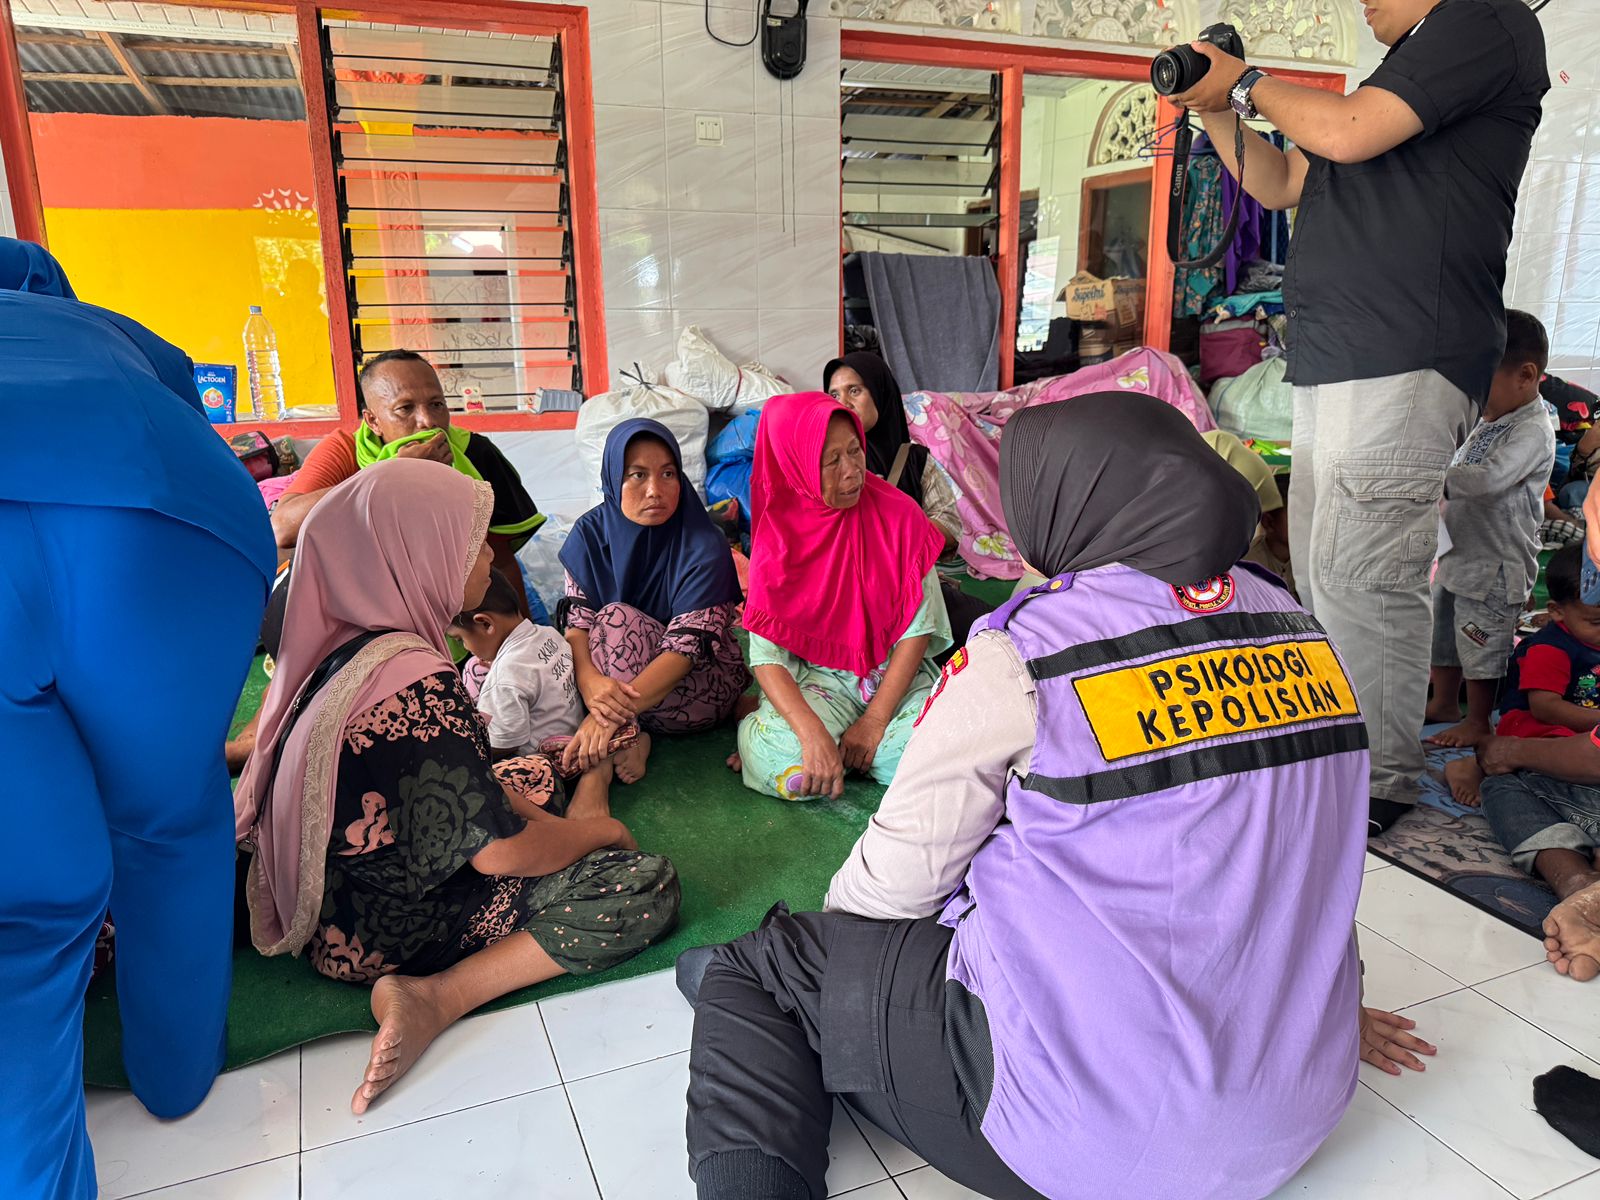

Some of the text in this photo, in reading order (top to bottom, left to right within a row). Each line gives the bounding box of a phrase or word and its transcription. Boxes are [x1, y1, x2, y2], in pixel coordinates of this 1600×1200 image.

[1172, 164, 1183, 197] Canon
[197, 375, 227, 384] LACTOGEN
[1149, 646, 1313, 700] PSIKOLOGI
[1136, 680, 1342, 745] KEPOLISIAN
